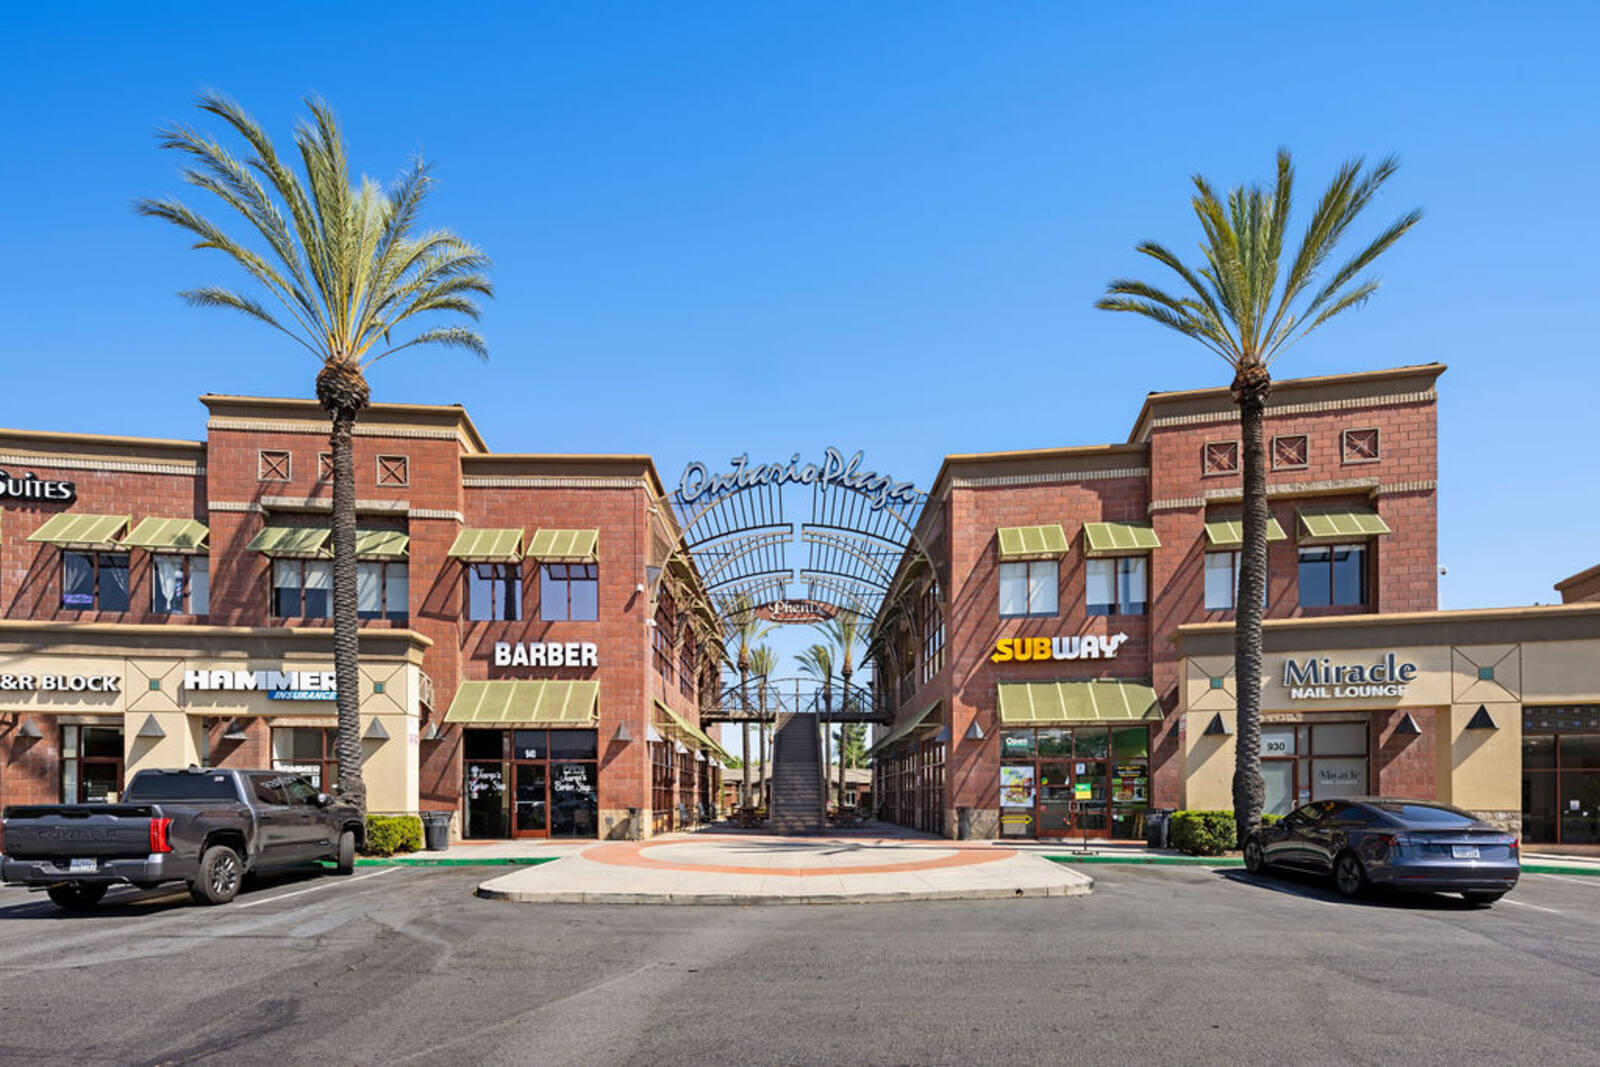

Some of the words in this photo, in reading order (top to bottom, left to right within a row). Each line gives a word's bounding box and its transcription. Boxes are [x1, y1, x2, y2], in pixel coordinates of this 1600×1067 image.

[679, 452, 817, 503] Ontario
[821, 446, 917, 511] Plaza
[495, 642, 598, 667] BARBER
[991, 632, 1129, 663] SUBWAY
[1283, 651, 1417, 687] Miracle
[42, 675, 119, 691] BLOCK
[184, 670, 337, 690] HAMMER
[274, 691, 337, 700] INSURANCE
[1291, 687, 1331, 699] NAIL
[1334, 685, 1409, 698] LOUNGE
[1267, 742, 1285, 751] 930
